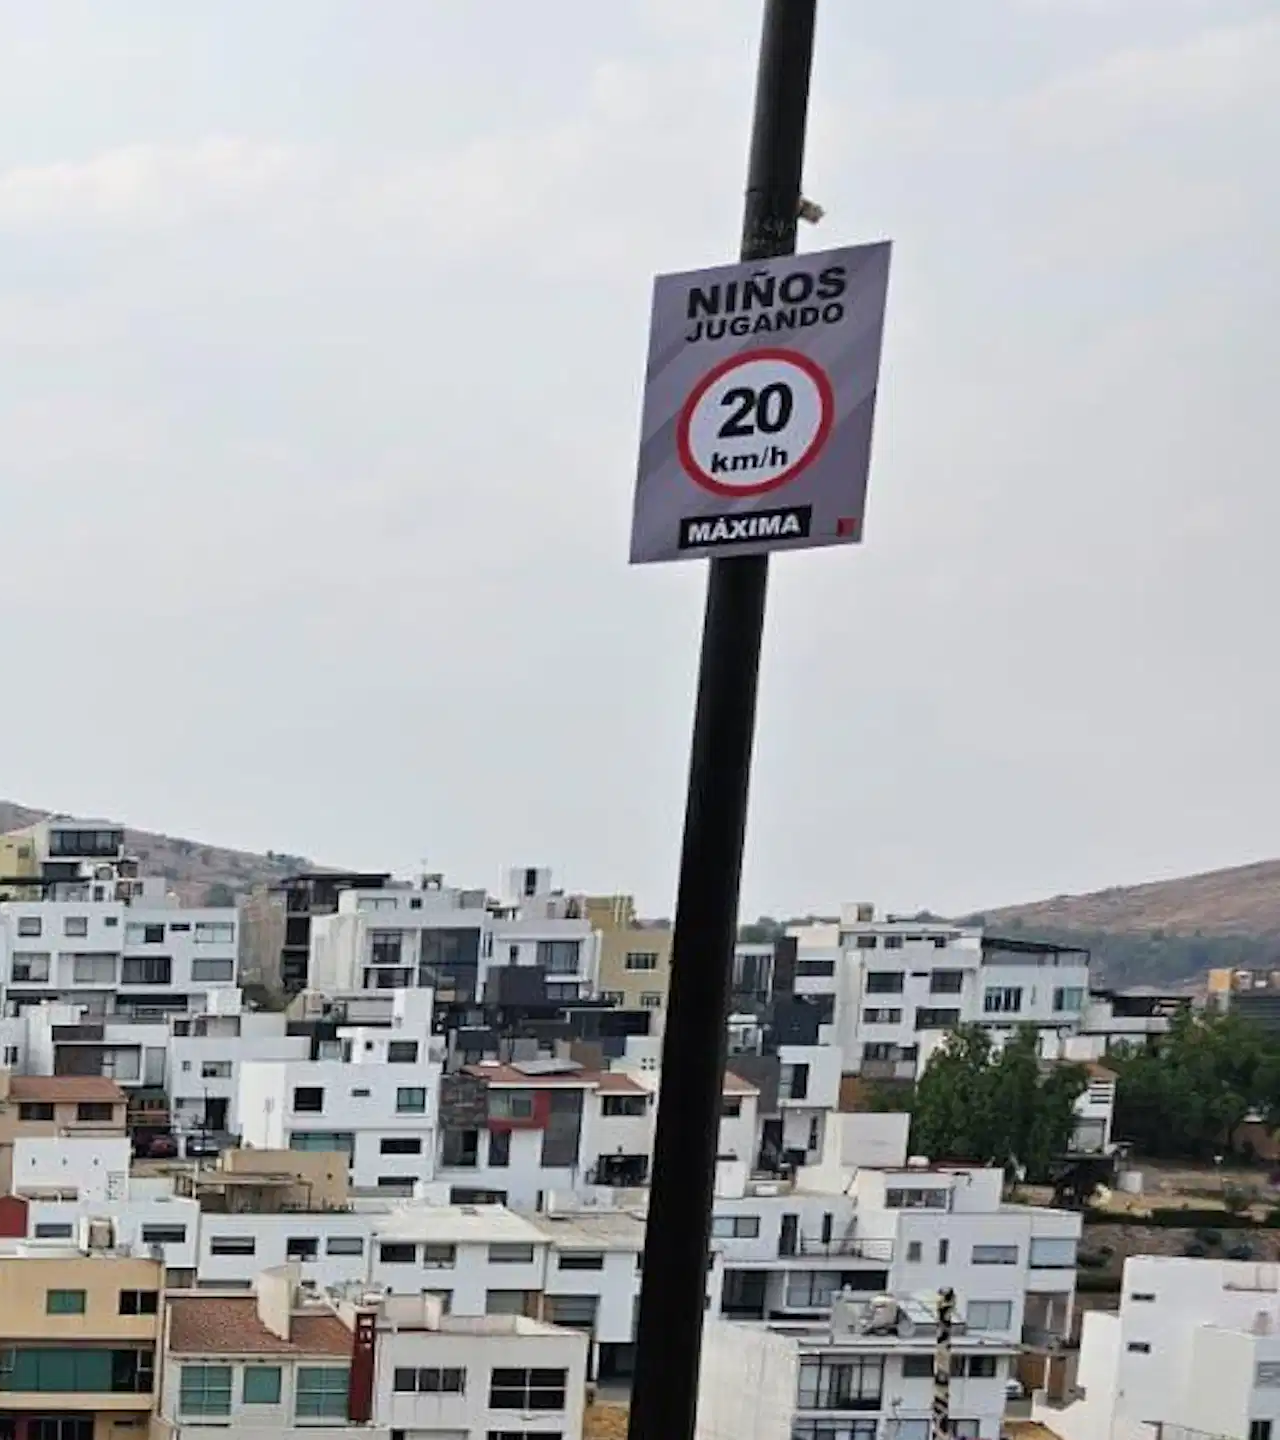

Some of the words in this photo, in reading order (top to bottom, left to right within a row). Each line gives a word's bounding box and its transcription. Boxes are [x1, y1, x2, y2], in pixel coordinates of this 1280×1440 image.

[687, 267, 846, 318] NIÑOS
[686, 303, 844, 342] JUGANDO
[718, 382, 793, 438] 20
[711, 446, 788, 473] km/h
[689, 514, 801, 542] MÁXIMA
